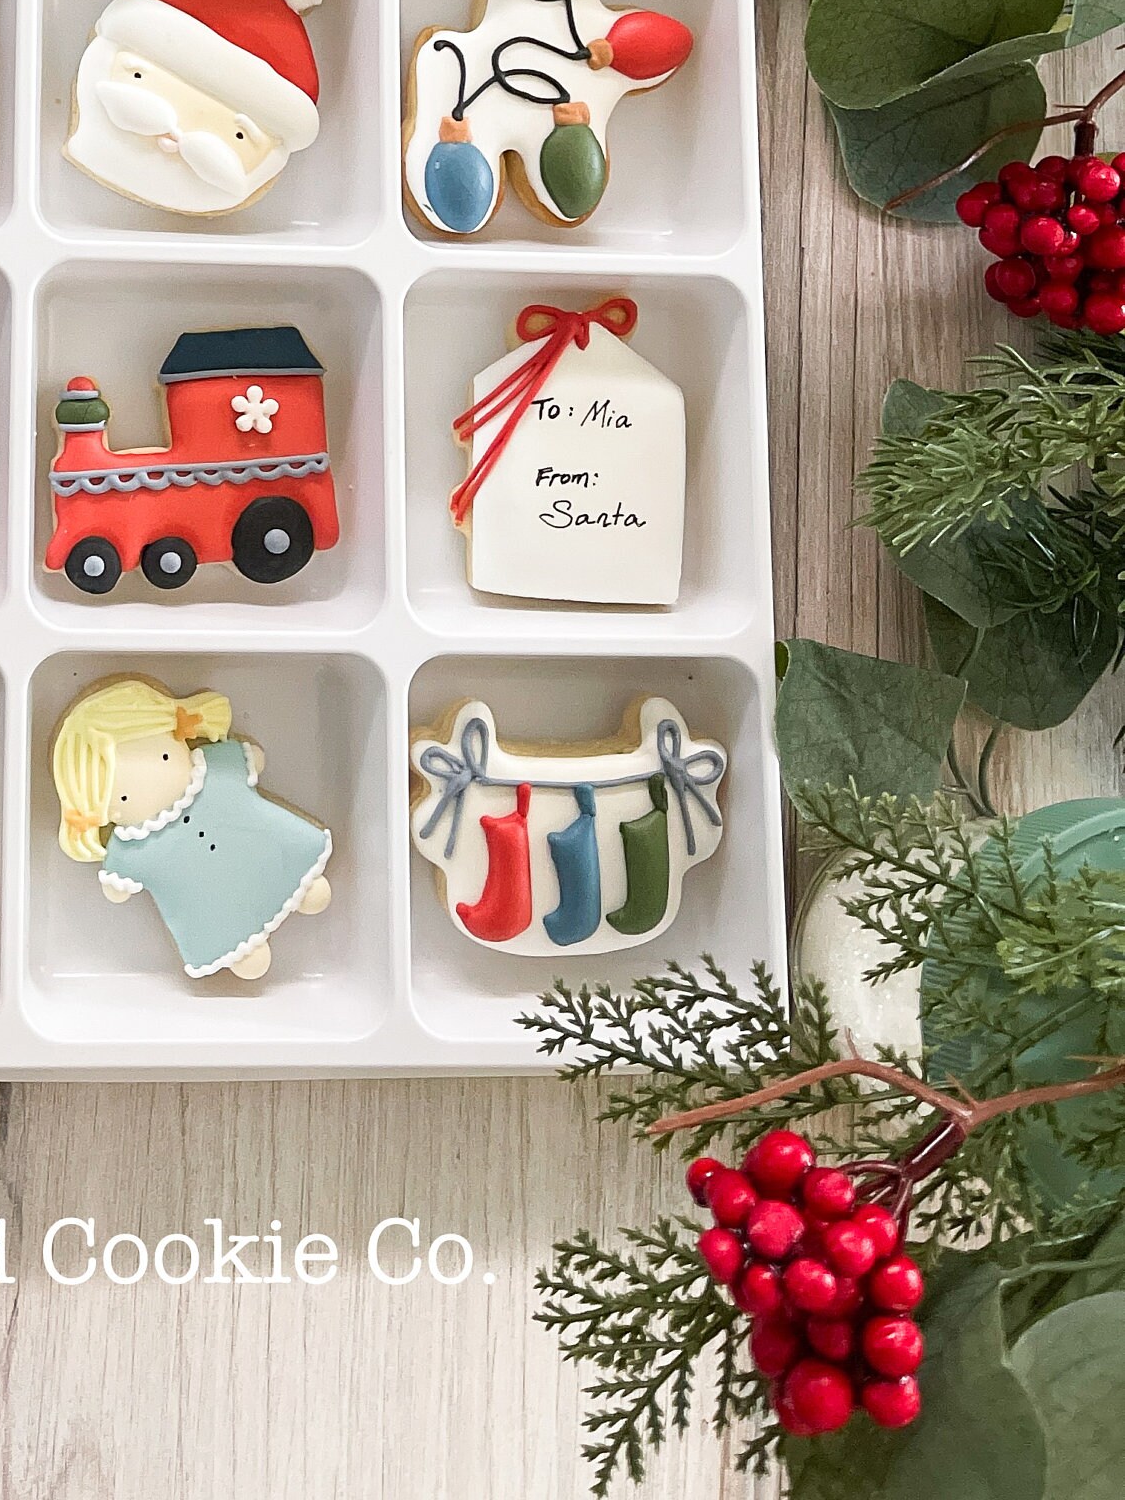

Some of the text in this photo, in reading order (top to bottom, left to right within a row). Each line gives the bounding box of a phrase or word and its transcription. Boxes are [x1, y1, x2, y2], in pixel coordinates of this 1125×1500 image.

[580, 399, 632, 429] Mia
[535, 467, 599, 488] From:
[539, 500, 646, 529] Santa
